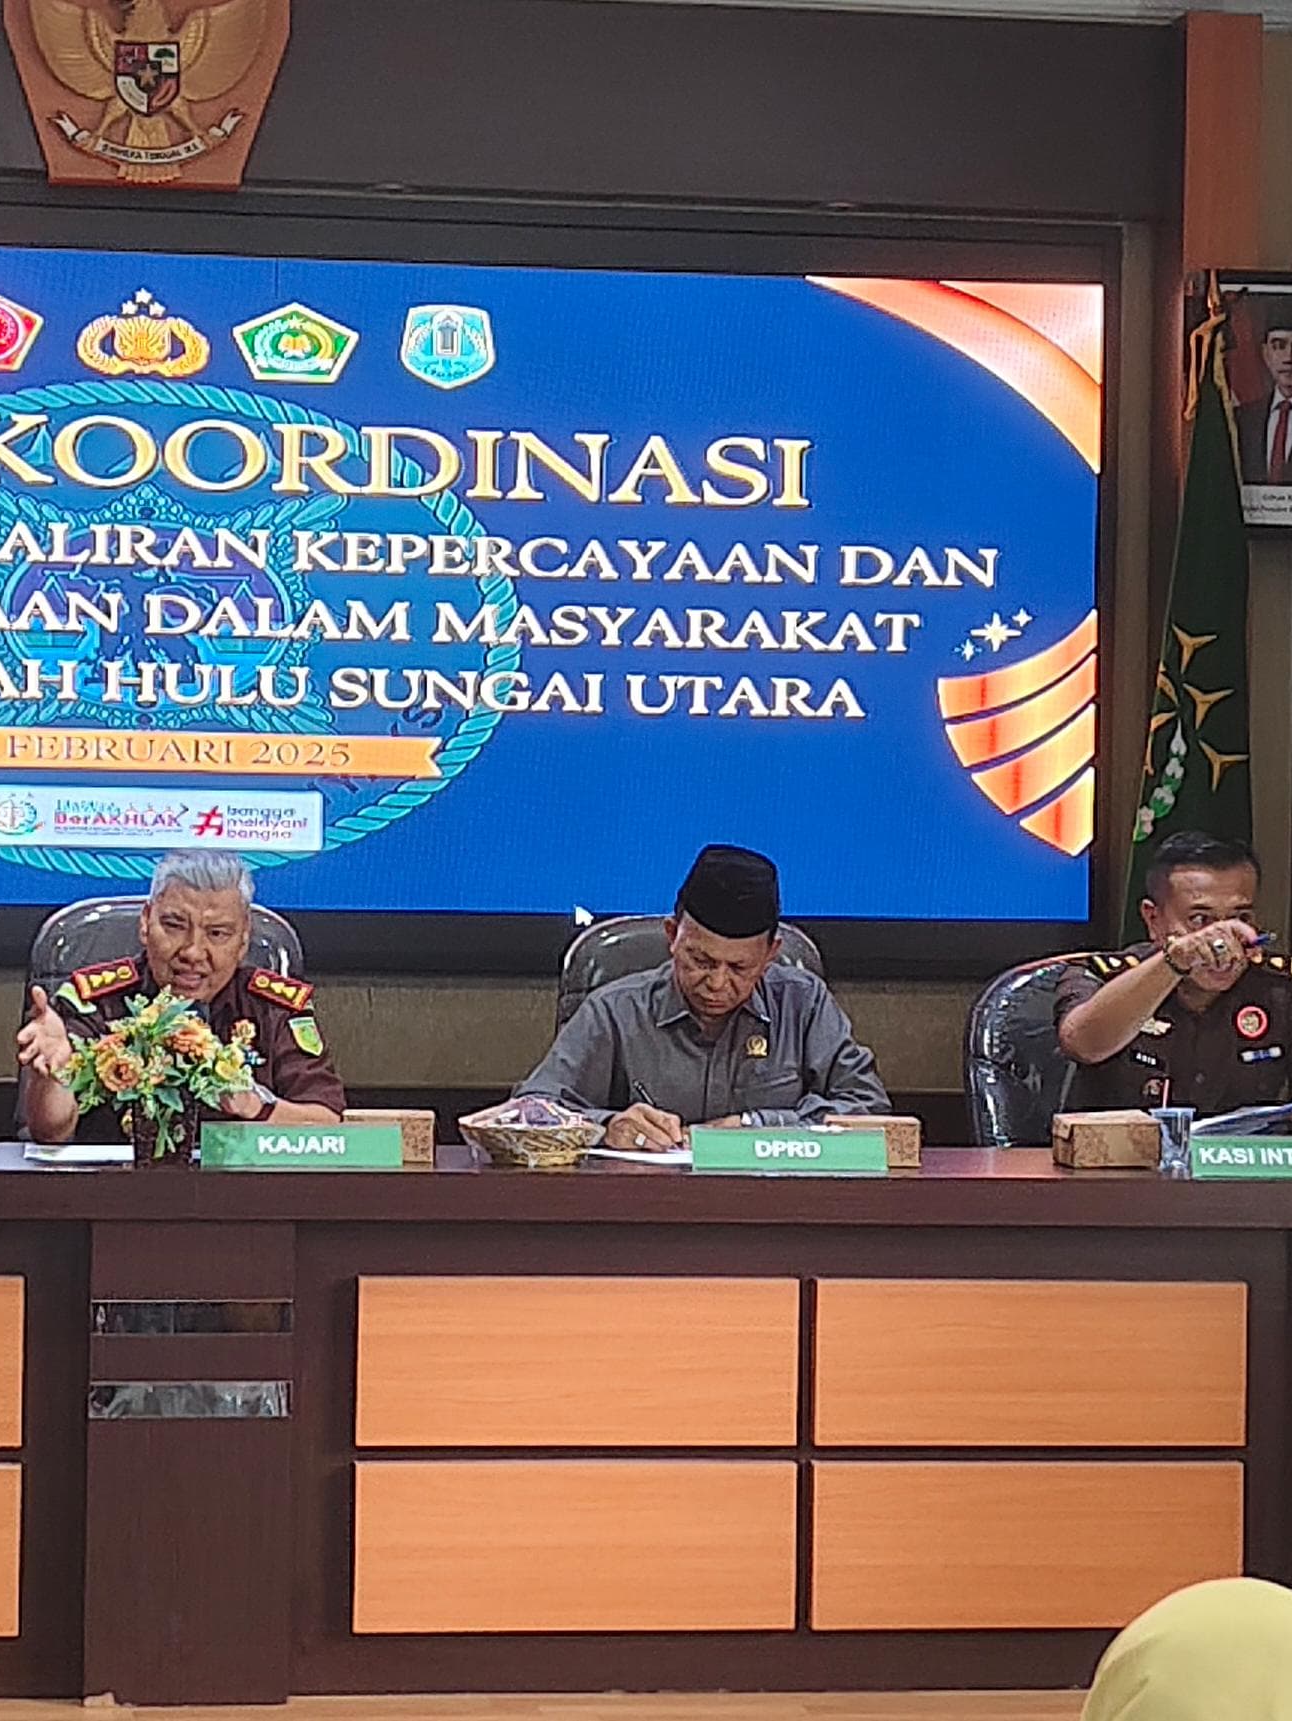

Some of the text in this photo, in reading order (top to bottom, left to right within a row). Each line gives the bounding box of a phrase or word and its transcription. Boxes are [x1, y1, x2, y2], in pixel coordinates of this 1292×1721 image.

[292, 531, 820, 584] KEPERCAYAAN
[840, 546, 999, 588] DAN
[144, 595, 412, 642] DALAM
[431, 601, 921, 652] MASYARAKAT
[102, 662, 310, 708] HULU
[330, 668, 604, 713] SUNGAI
[626, 674, 866, 718] UTARA
[8, 734, 233, 765] FEBRUARI
[251, 741, 351, 767] 2025
[258, 1134, 345, 1155] KAJARI
[754, 1140, 821, 1158] DPRD
[1199, 1147, 1255, 1165] KASI
